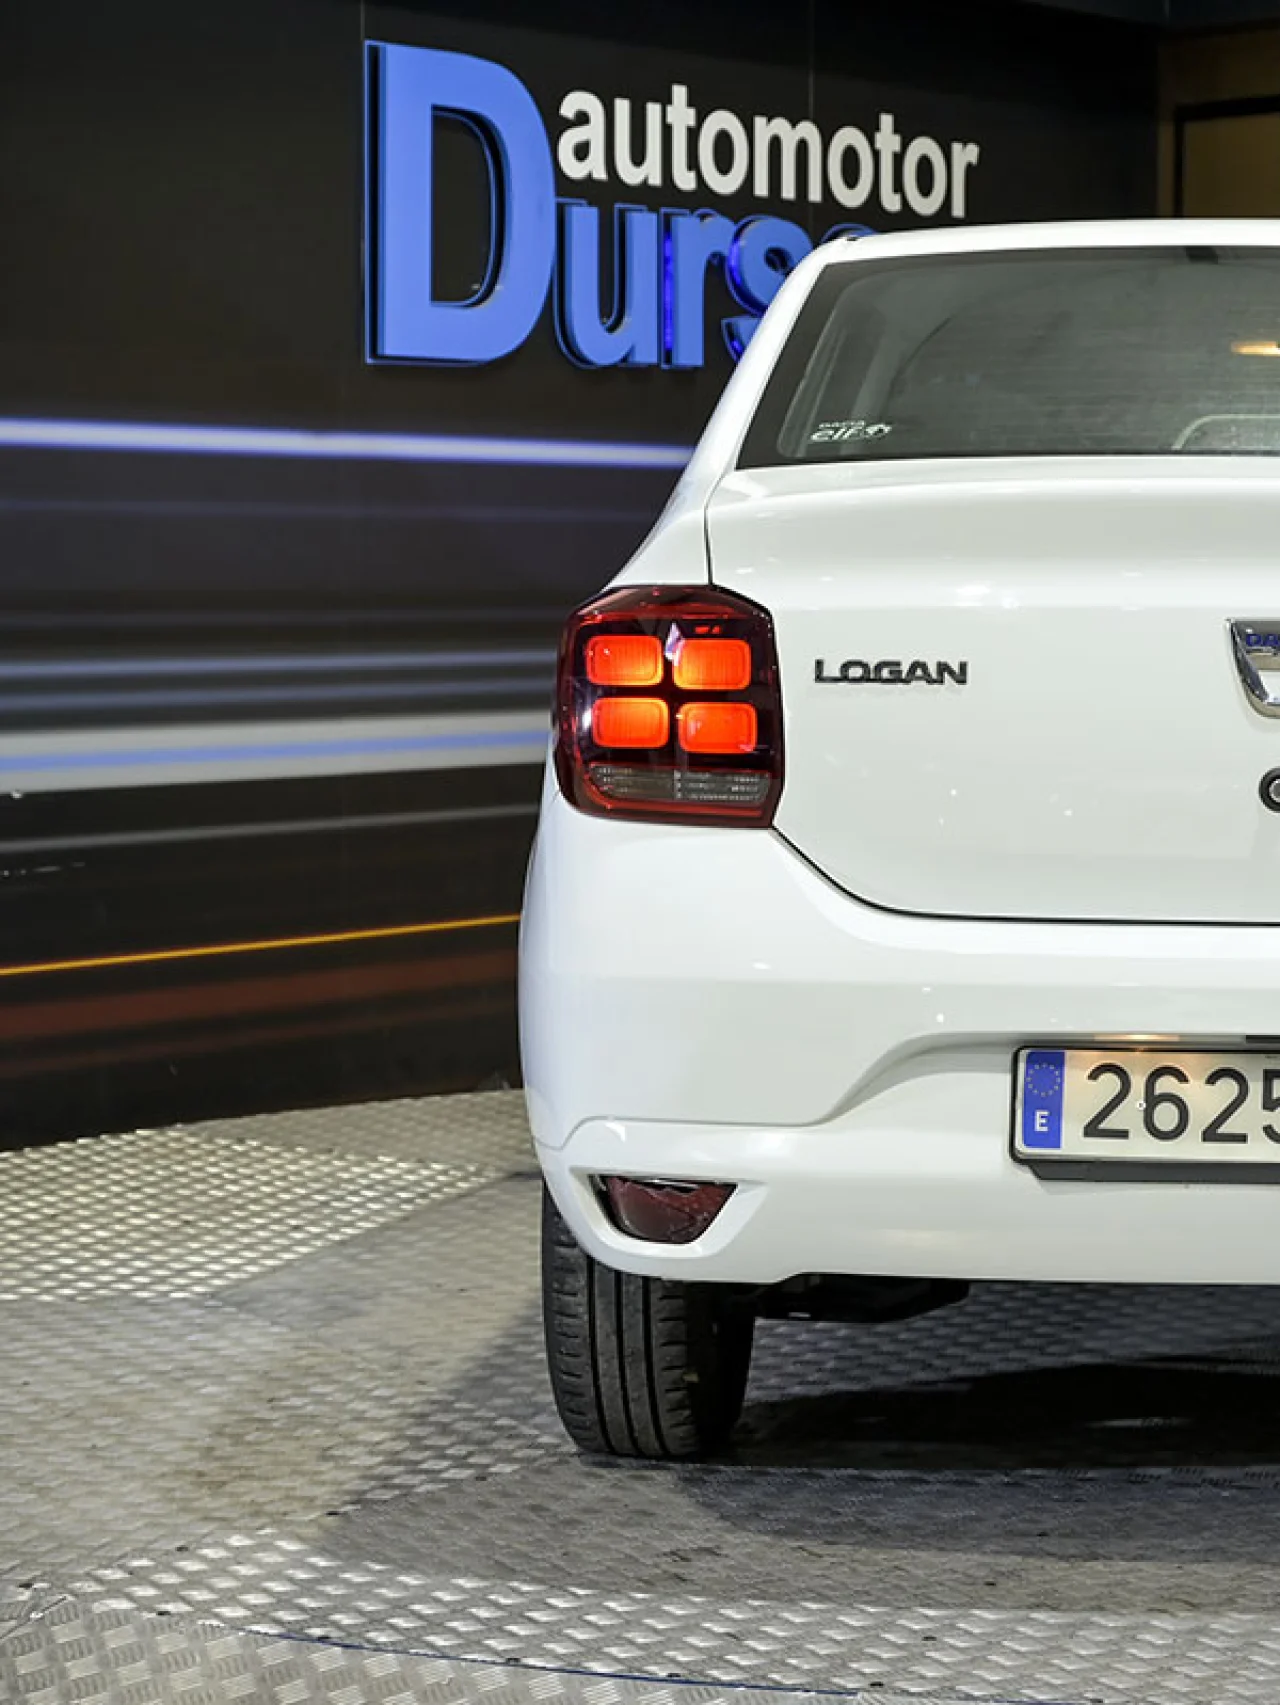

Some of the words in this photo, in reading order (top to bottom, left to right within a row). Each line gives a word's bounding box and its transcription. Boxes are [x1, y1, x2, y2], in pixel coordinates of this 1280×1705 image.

[557, 84, 980, 218] automotor
[365, 40, 879, 369] Durs
[814, 658, 968, 686] LOGAN
[1033, 1109, 1050, 1133] E
